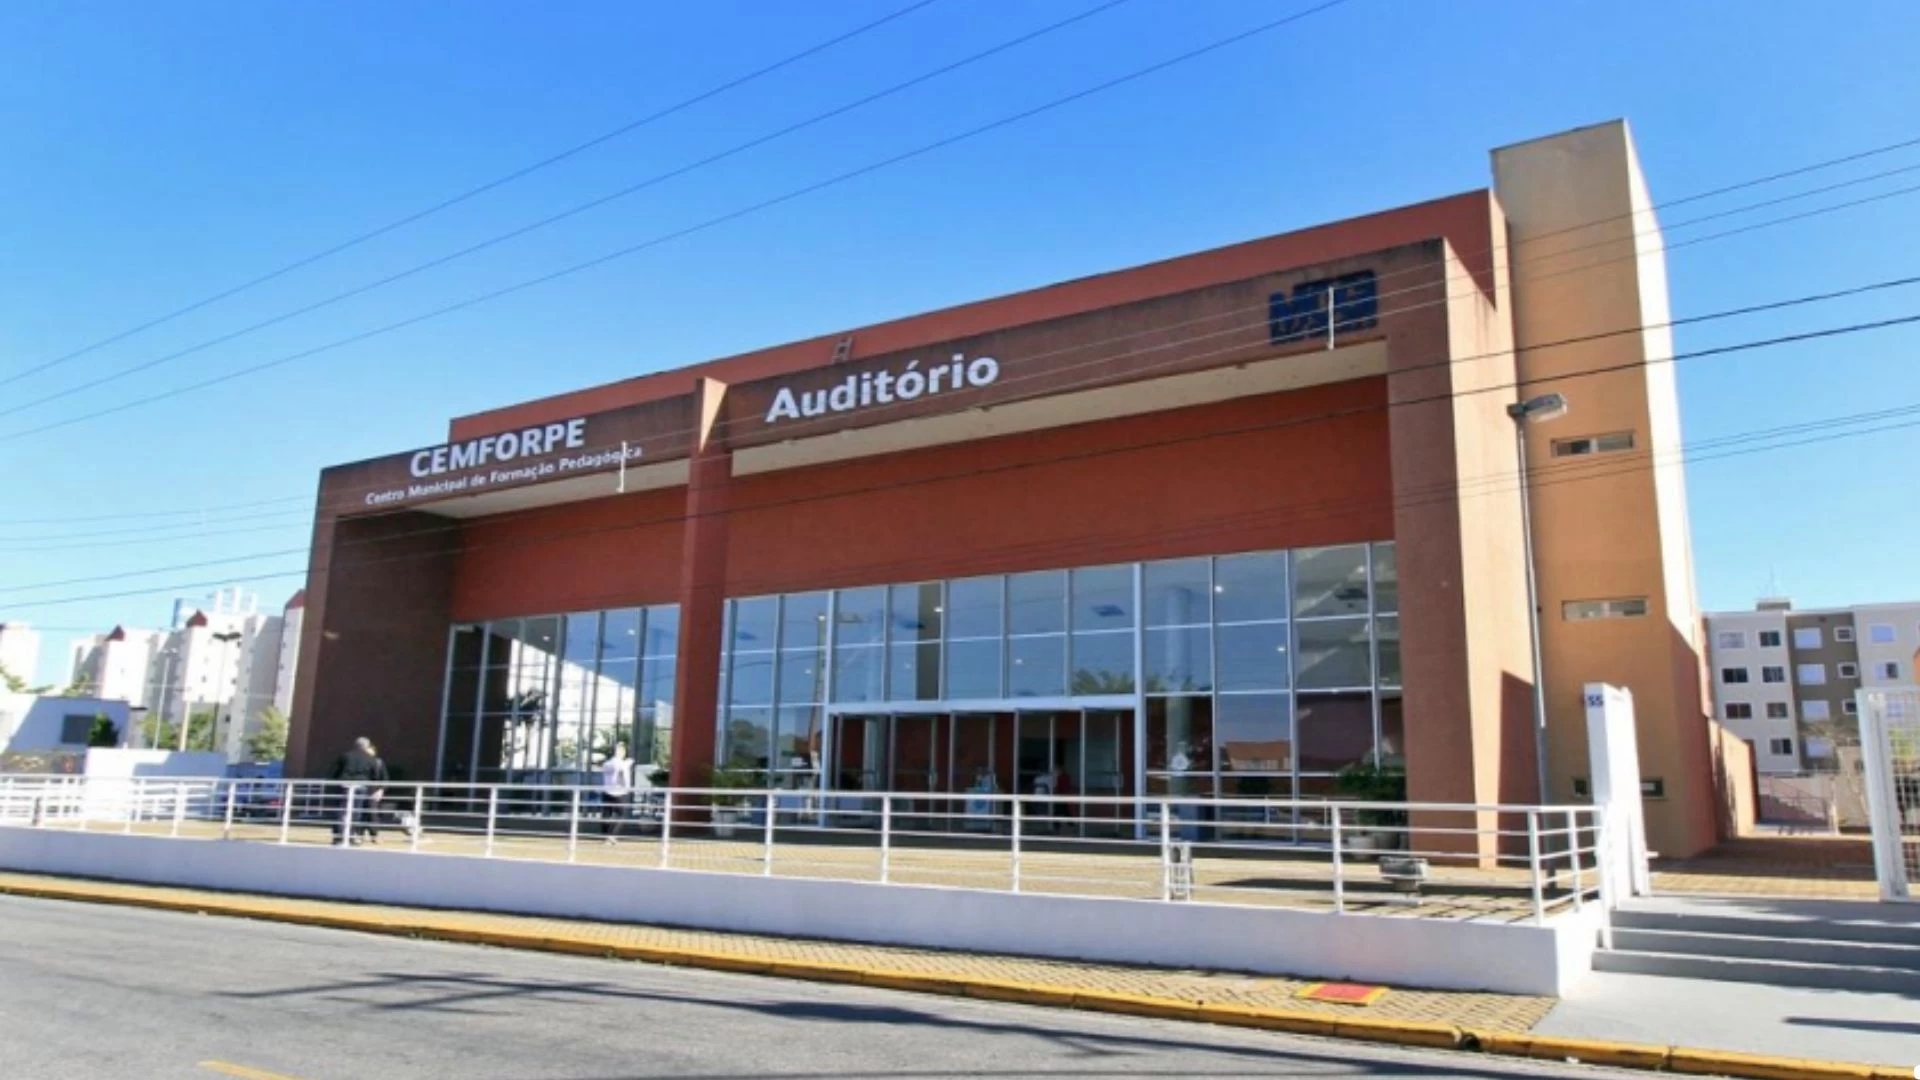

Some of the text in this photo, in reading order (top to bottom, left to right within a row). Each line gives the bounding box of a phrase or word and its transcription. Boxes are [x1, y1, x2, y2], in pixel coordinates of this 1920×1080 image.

[765, 353, 999, 423] Auditório
[365, 446, 643, 505] Centro Municipal de Formação Pedagógca
[410, 418, 586, 478] CEMFORPE
